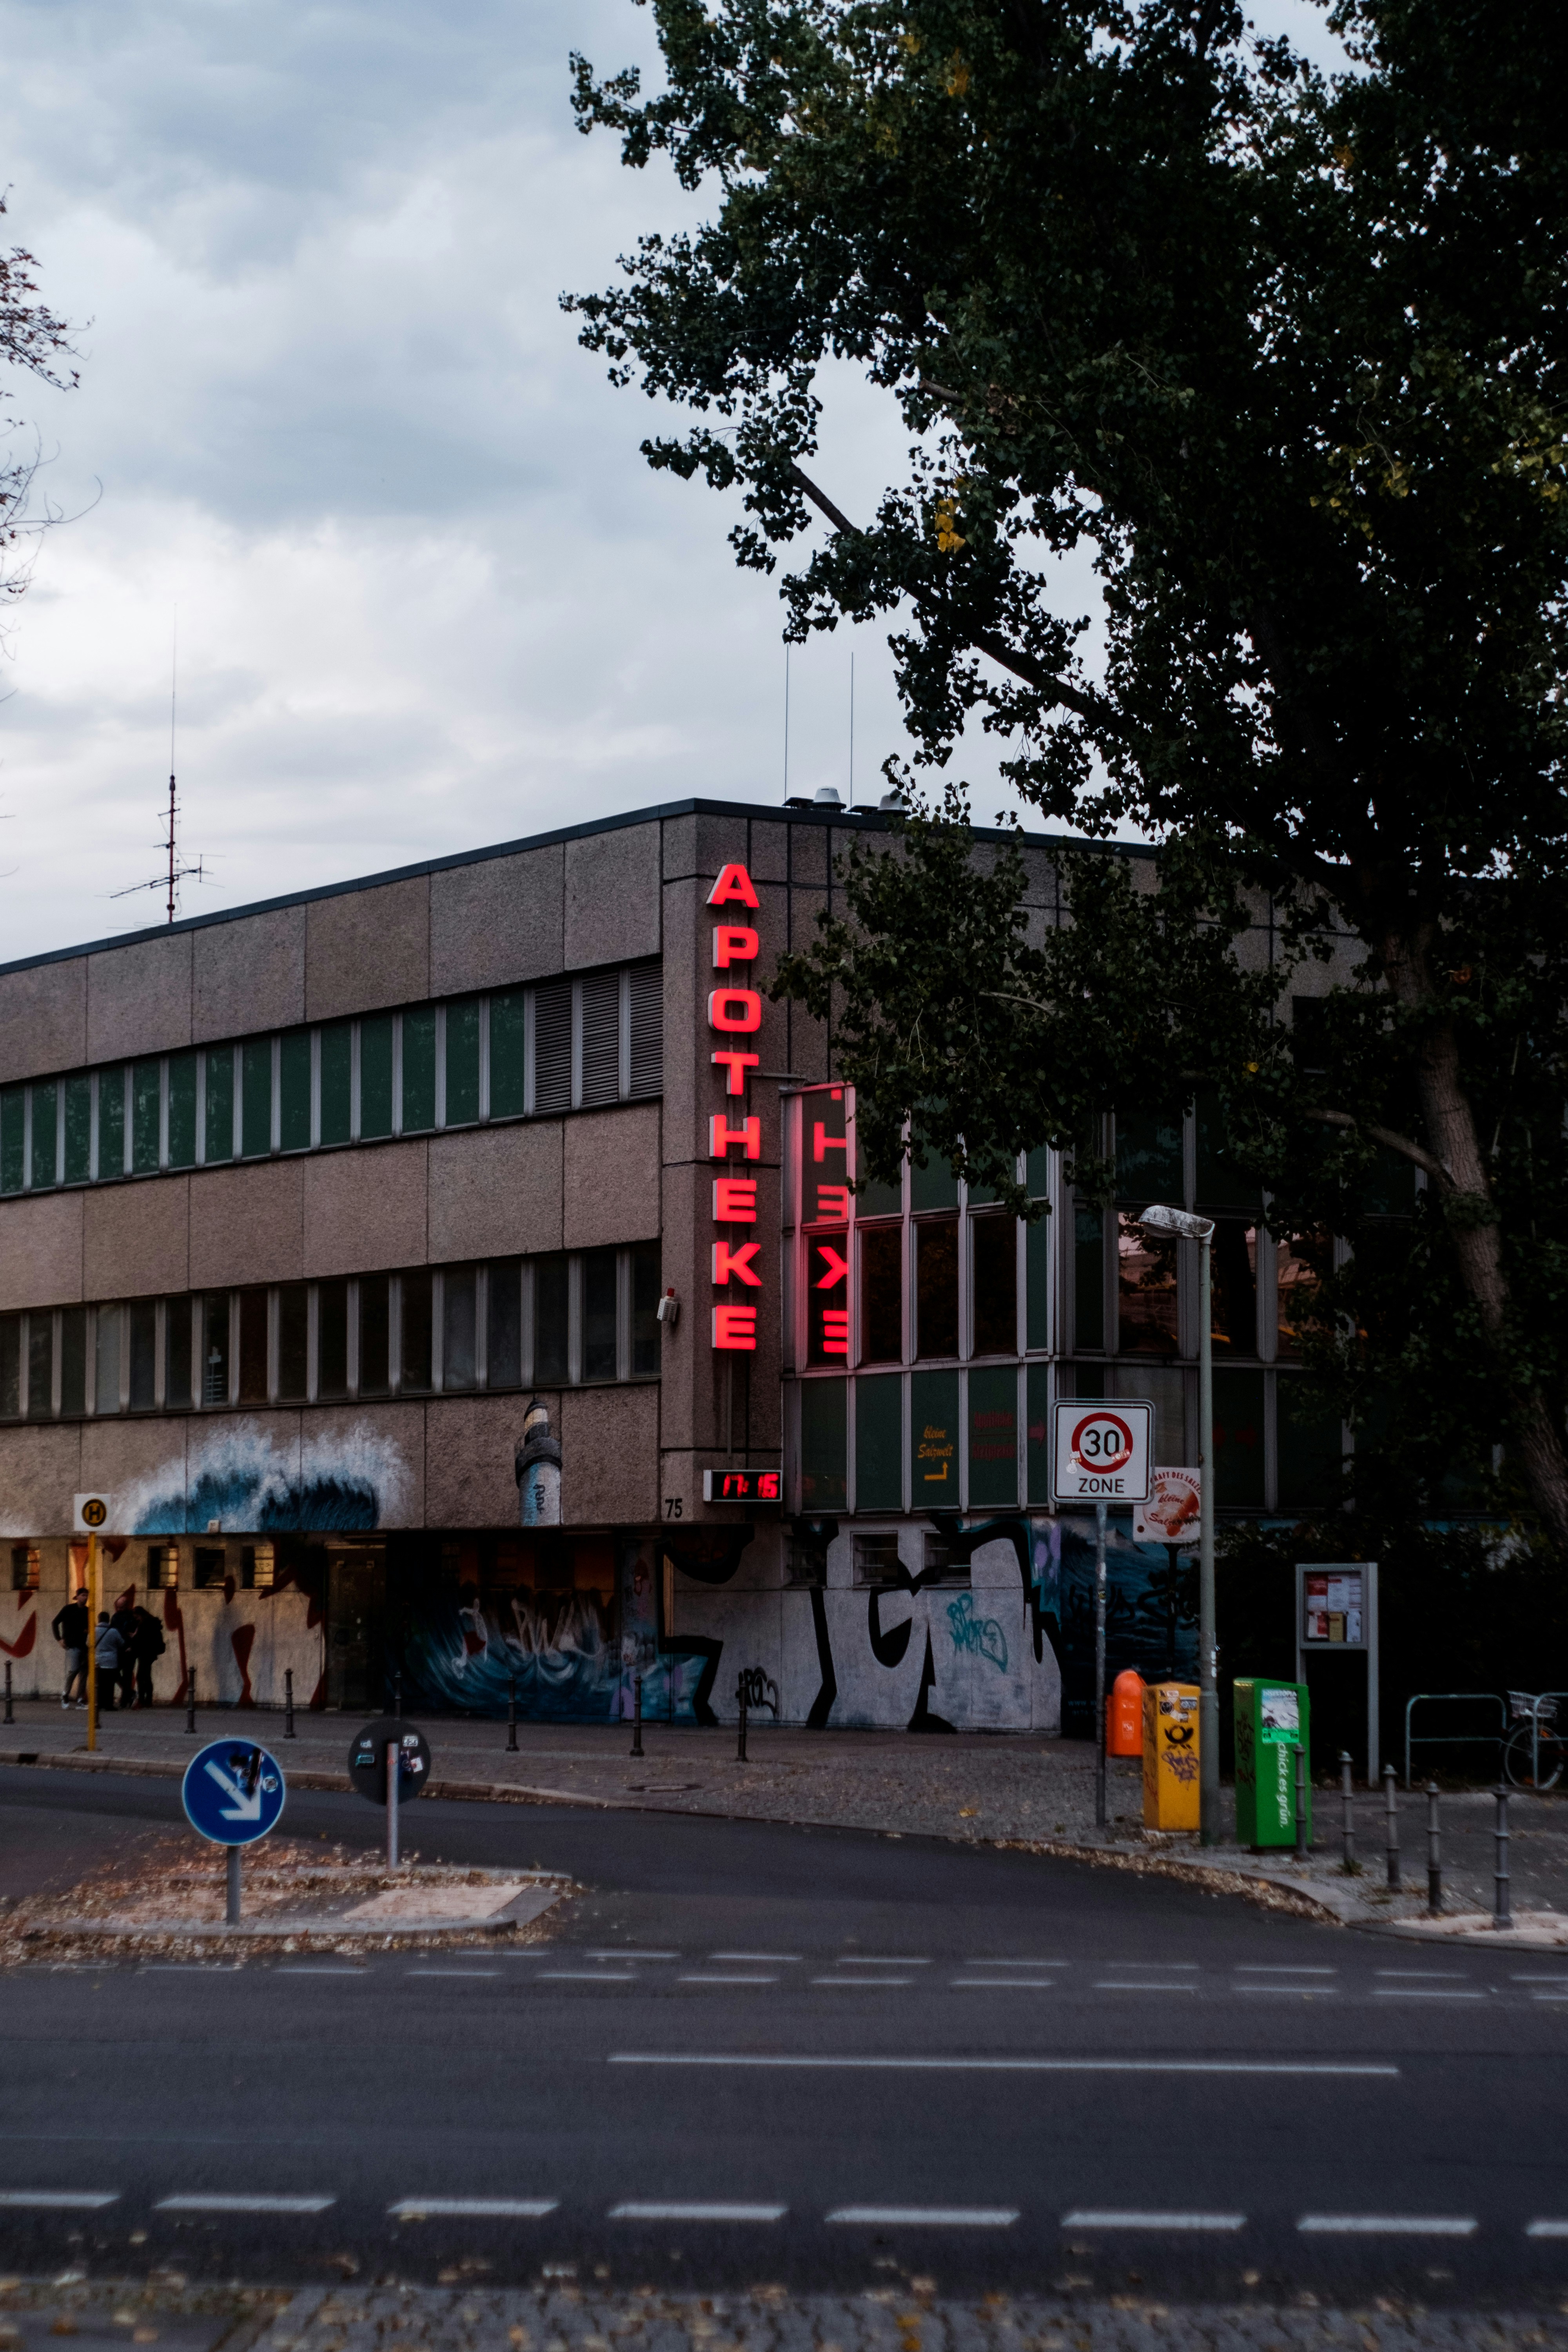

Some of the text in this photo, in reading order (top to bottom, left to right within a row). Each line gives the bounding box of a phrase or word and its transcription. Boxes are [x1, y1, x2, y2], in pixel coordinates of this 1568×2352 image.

[706, 864, 761, 1350] APOTHEKE
[1084, 1429, 1120, 1457] 30
[1172, 1472, 1184, 1480] DES
[1078, 1478, 1125, 1493] ZONE
[89, 1506, 100, 1521] H
[665, 1498, 683, 1518] 75
[1277, 1741, 1289, 1777] chick
[1279, 1778, 1287, 1793] es
